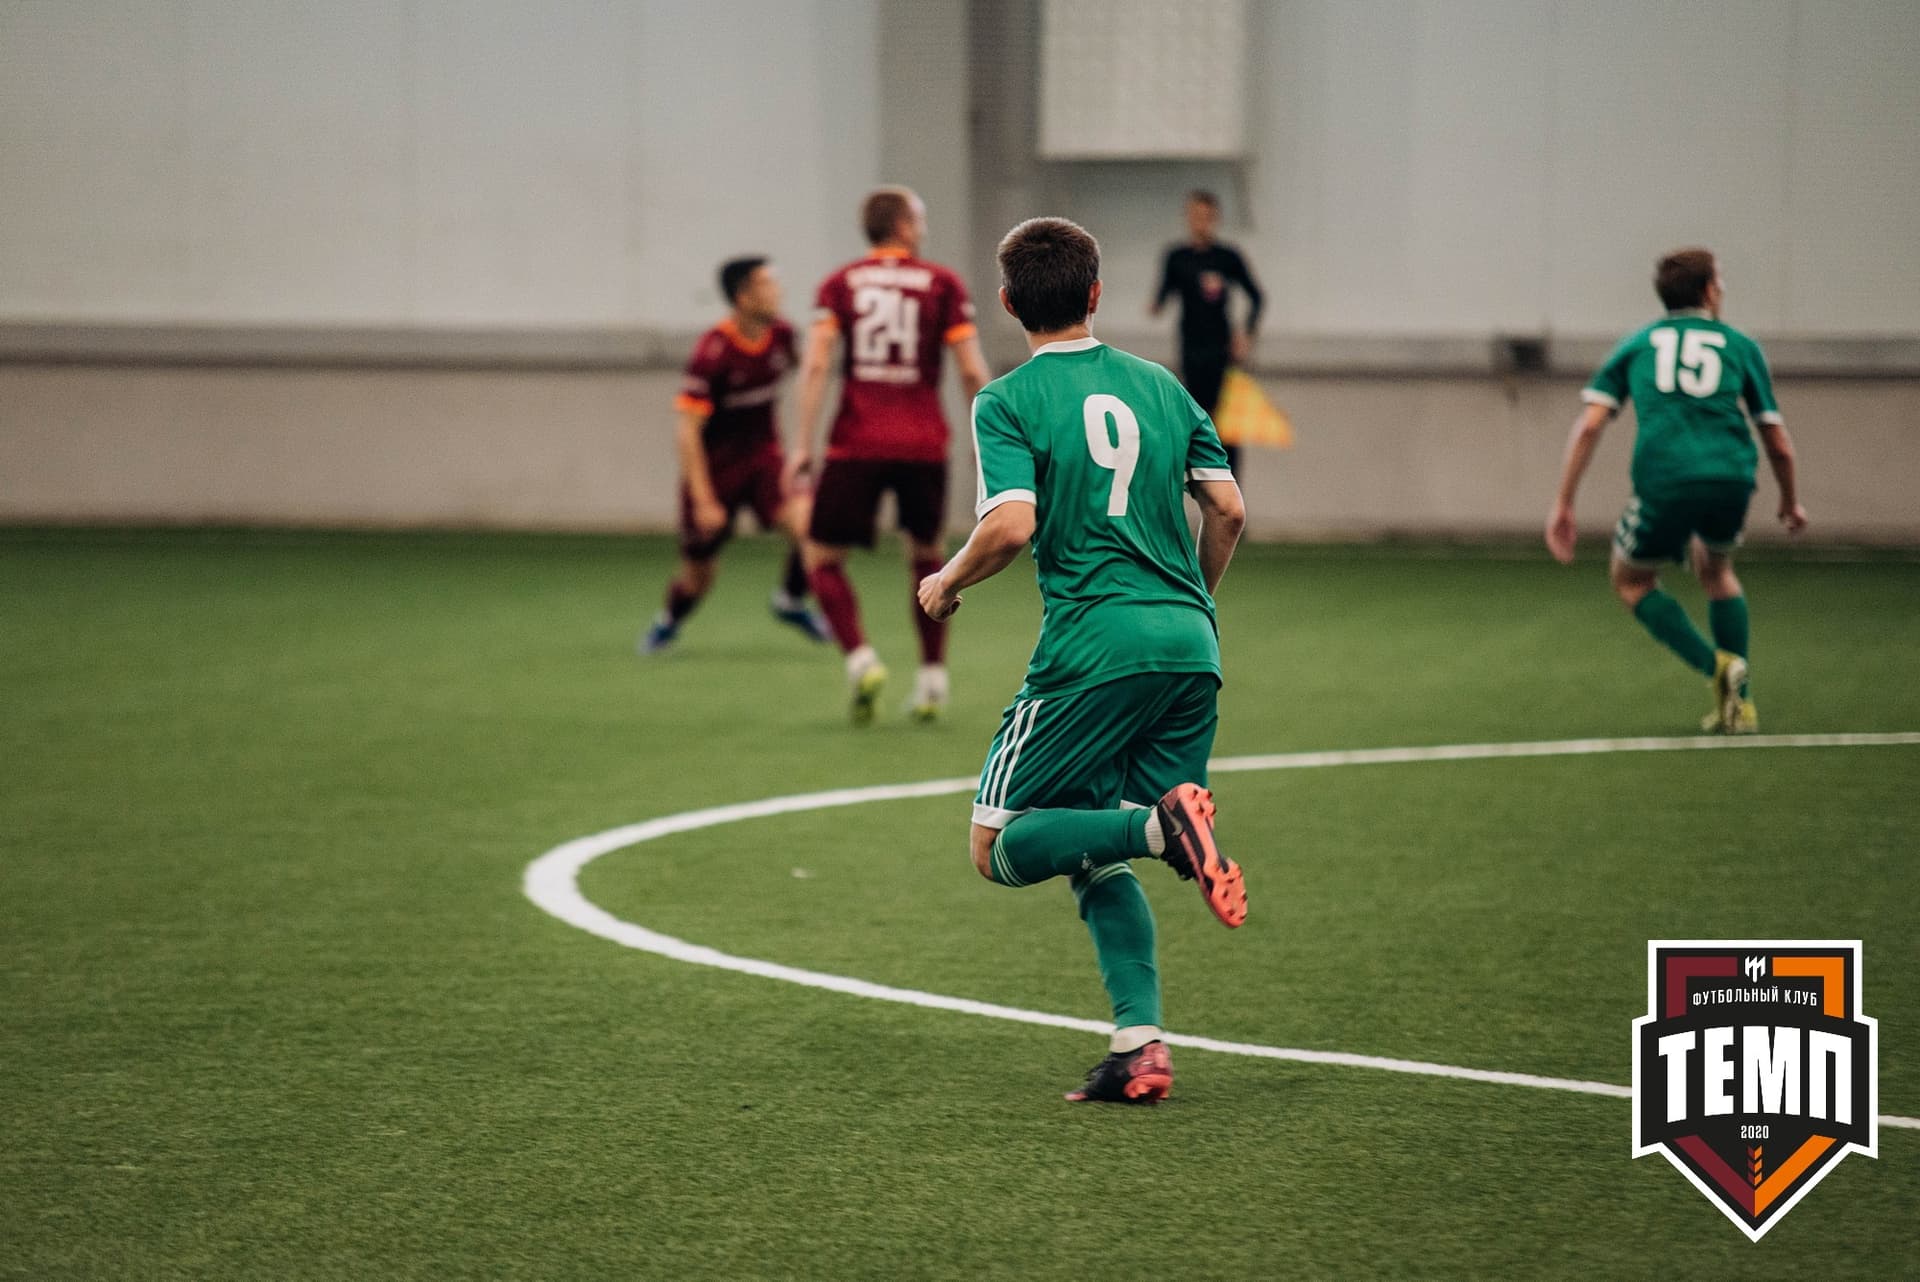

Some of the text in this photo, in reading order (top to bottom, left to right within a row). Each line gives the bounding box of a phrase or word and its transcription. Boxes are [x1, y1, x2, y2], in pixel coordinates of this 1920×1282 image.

[853, 287, 920, 363] 24
[1649, 327, 1727, 398] 15
[1083, 394, 1140, 516] 9
